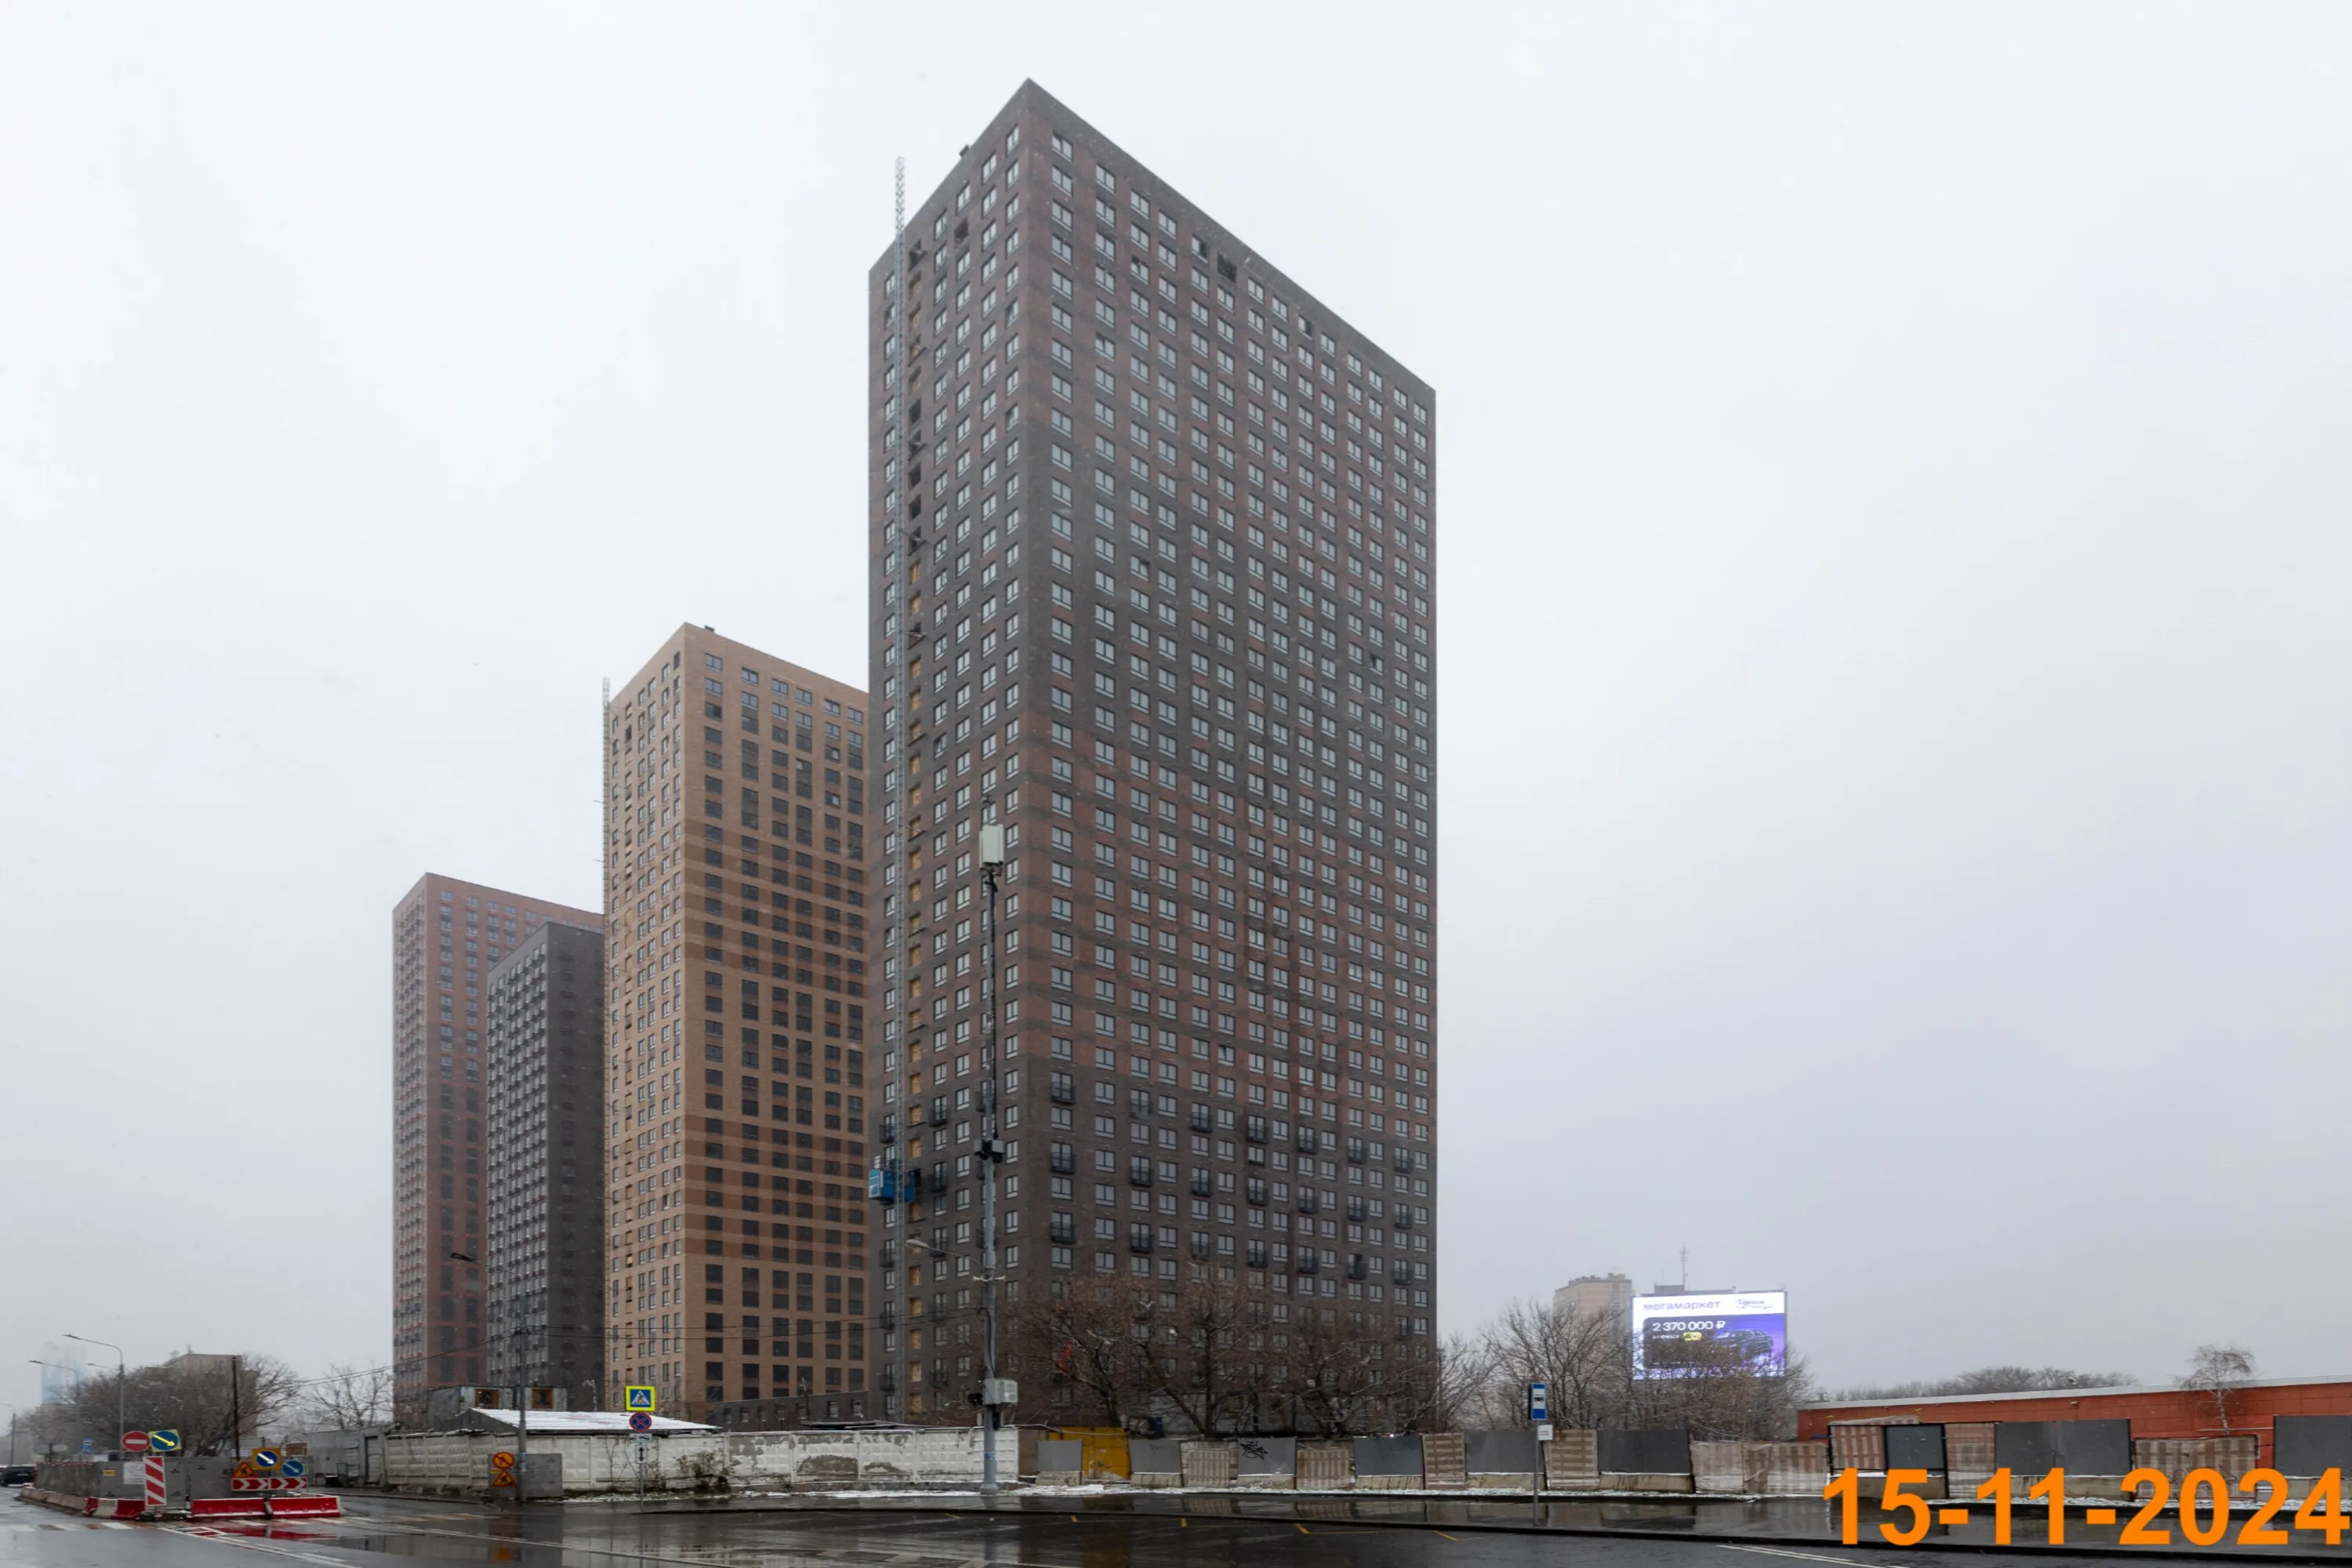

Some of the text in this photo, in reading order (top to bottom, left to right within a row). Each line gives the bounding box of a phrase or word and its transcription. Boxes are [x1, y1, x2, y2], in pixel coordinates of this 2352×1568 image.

[1643, 1301, 1721, 1310] мегамаркет
[1653, 1323, 1661, 1331] 2
[1663, 1322, 1686, 1330] 370
[1688, 1321, 1713, 1330] 000
